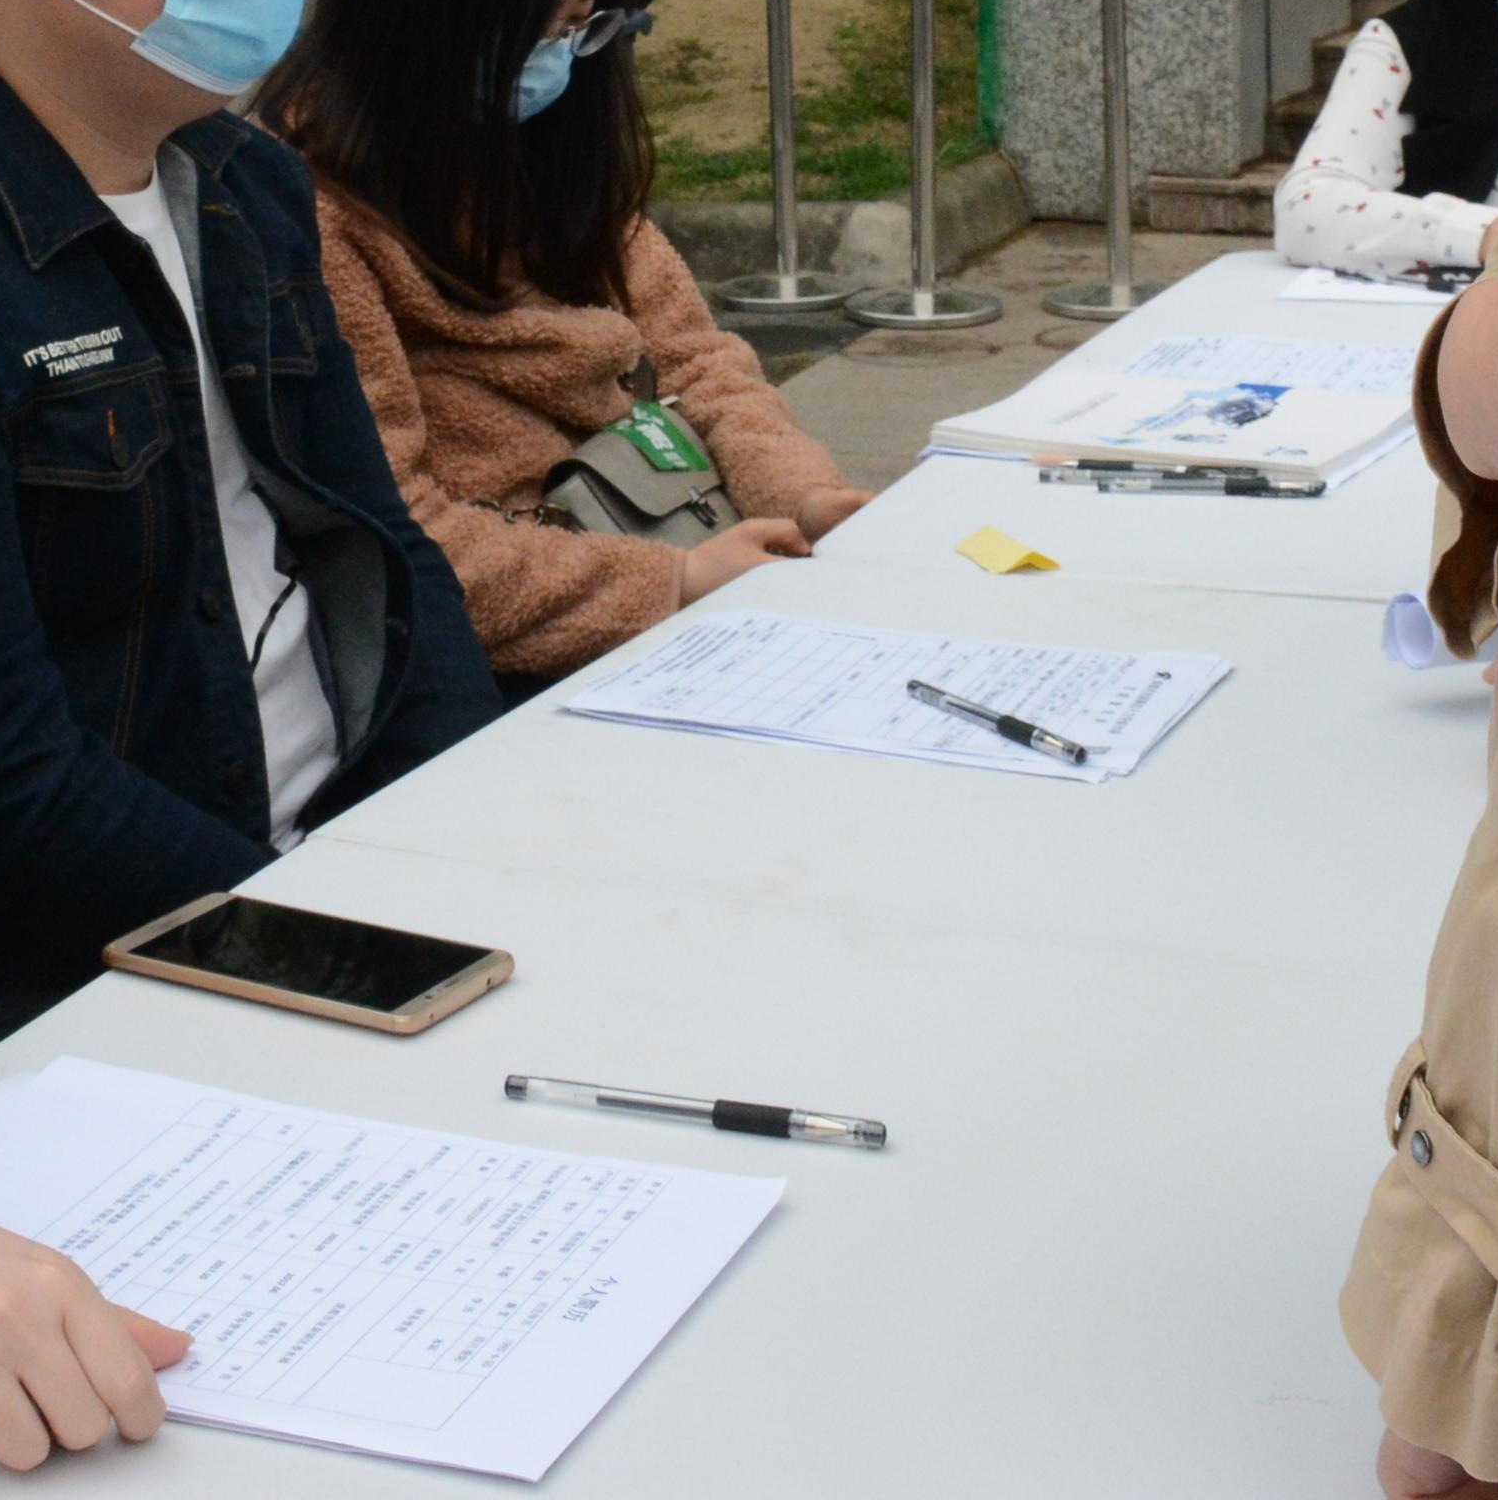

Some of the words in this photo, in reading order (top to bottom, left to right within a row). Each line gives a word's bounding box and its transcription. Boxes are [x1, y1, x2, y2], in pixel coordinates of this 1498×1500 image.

[101, 325, 124, 345] OUT
[559, 1273, 621, 1323] 个人简历
